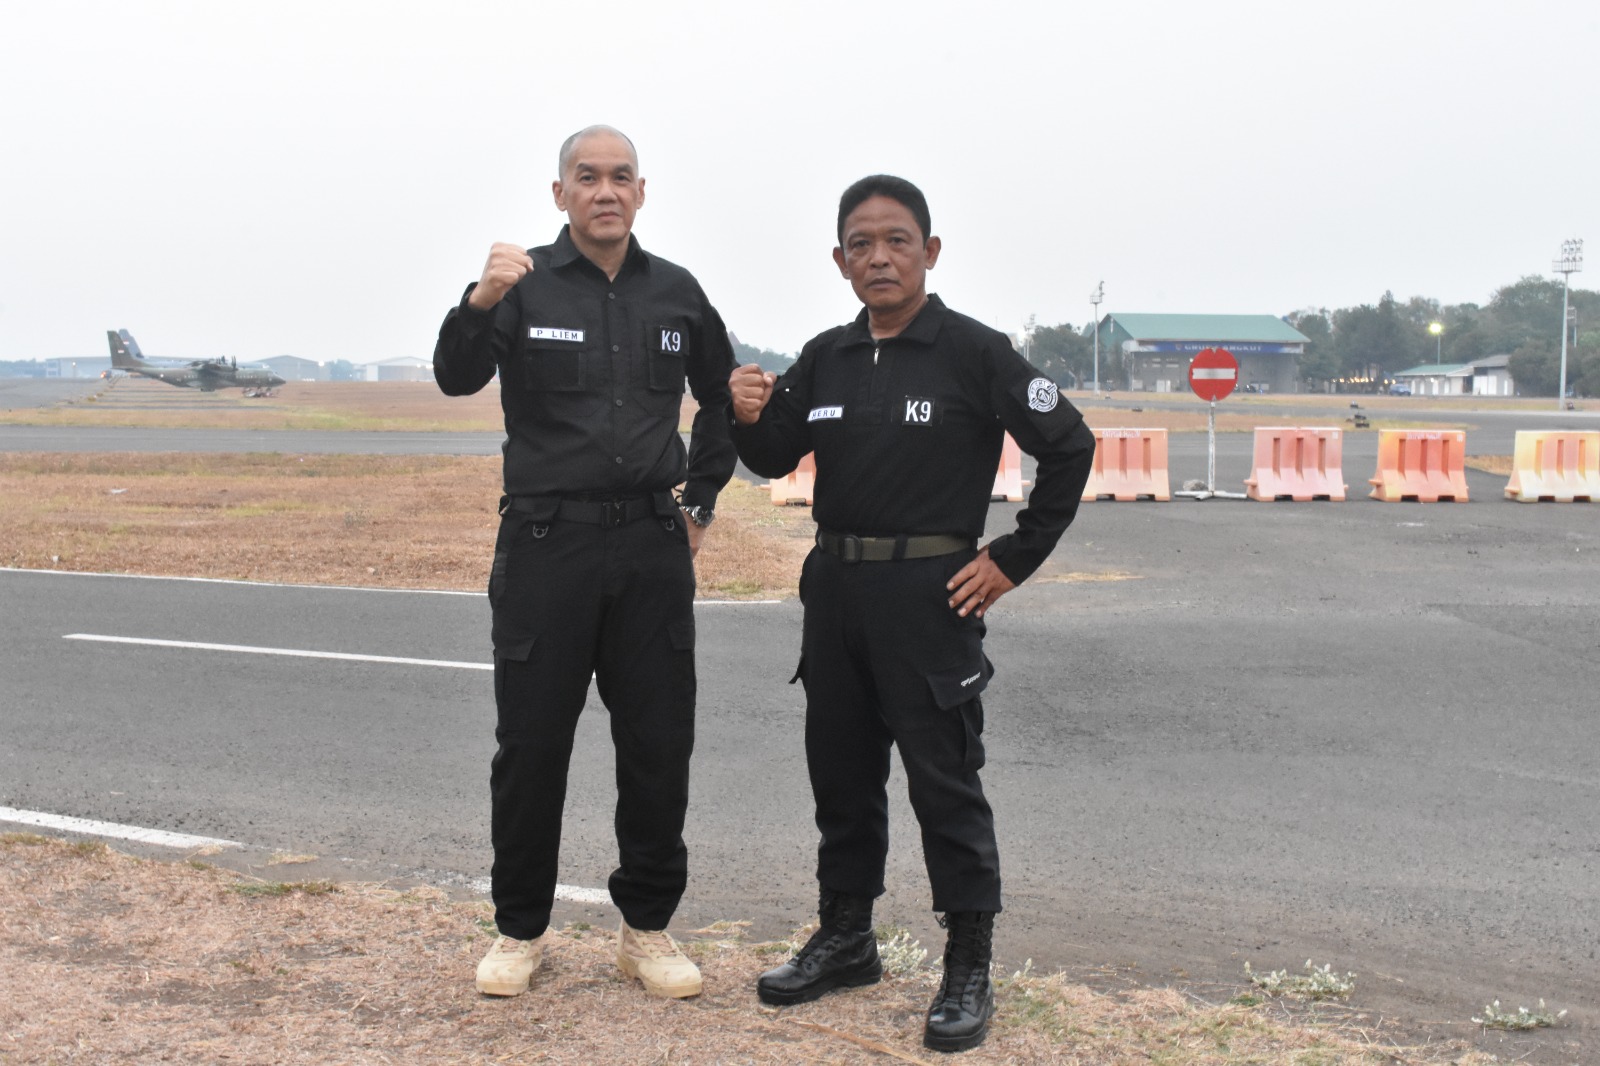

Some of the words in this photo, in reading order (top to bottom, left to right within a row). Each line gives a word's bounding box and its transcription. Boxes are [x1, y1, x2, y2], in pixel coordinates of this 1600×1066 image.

[552, 331, 578, 340] LIEM
[662, 330, 681, 352] K9
[811, 409, 836, 420] HERU
[905, 400, 931, 422] K9
